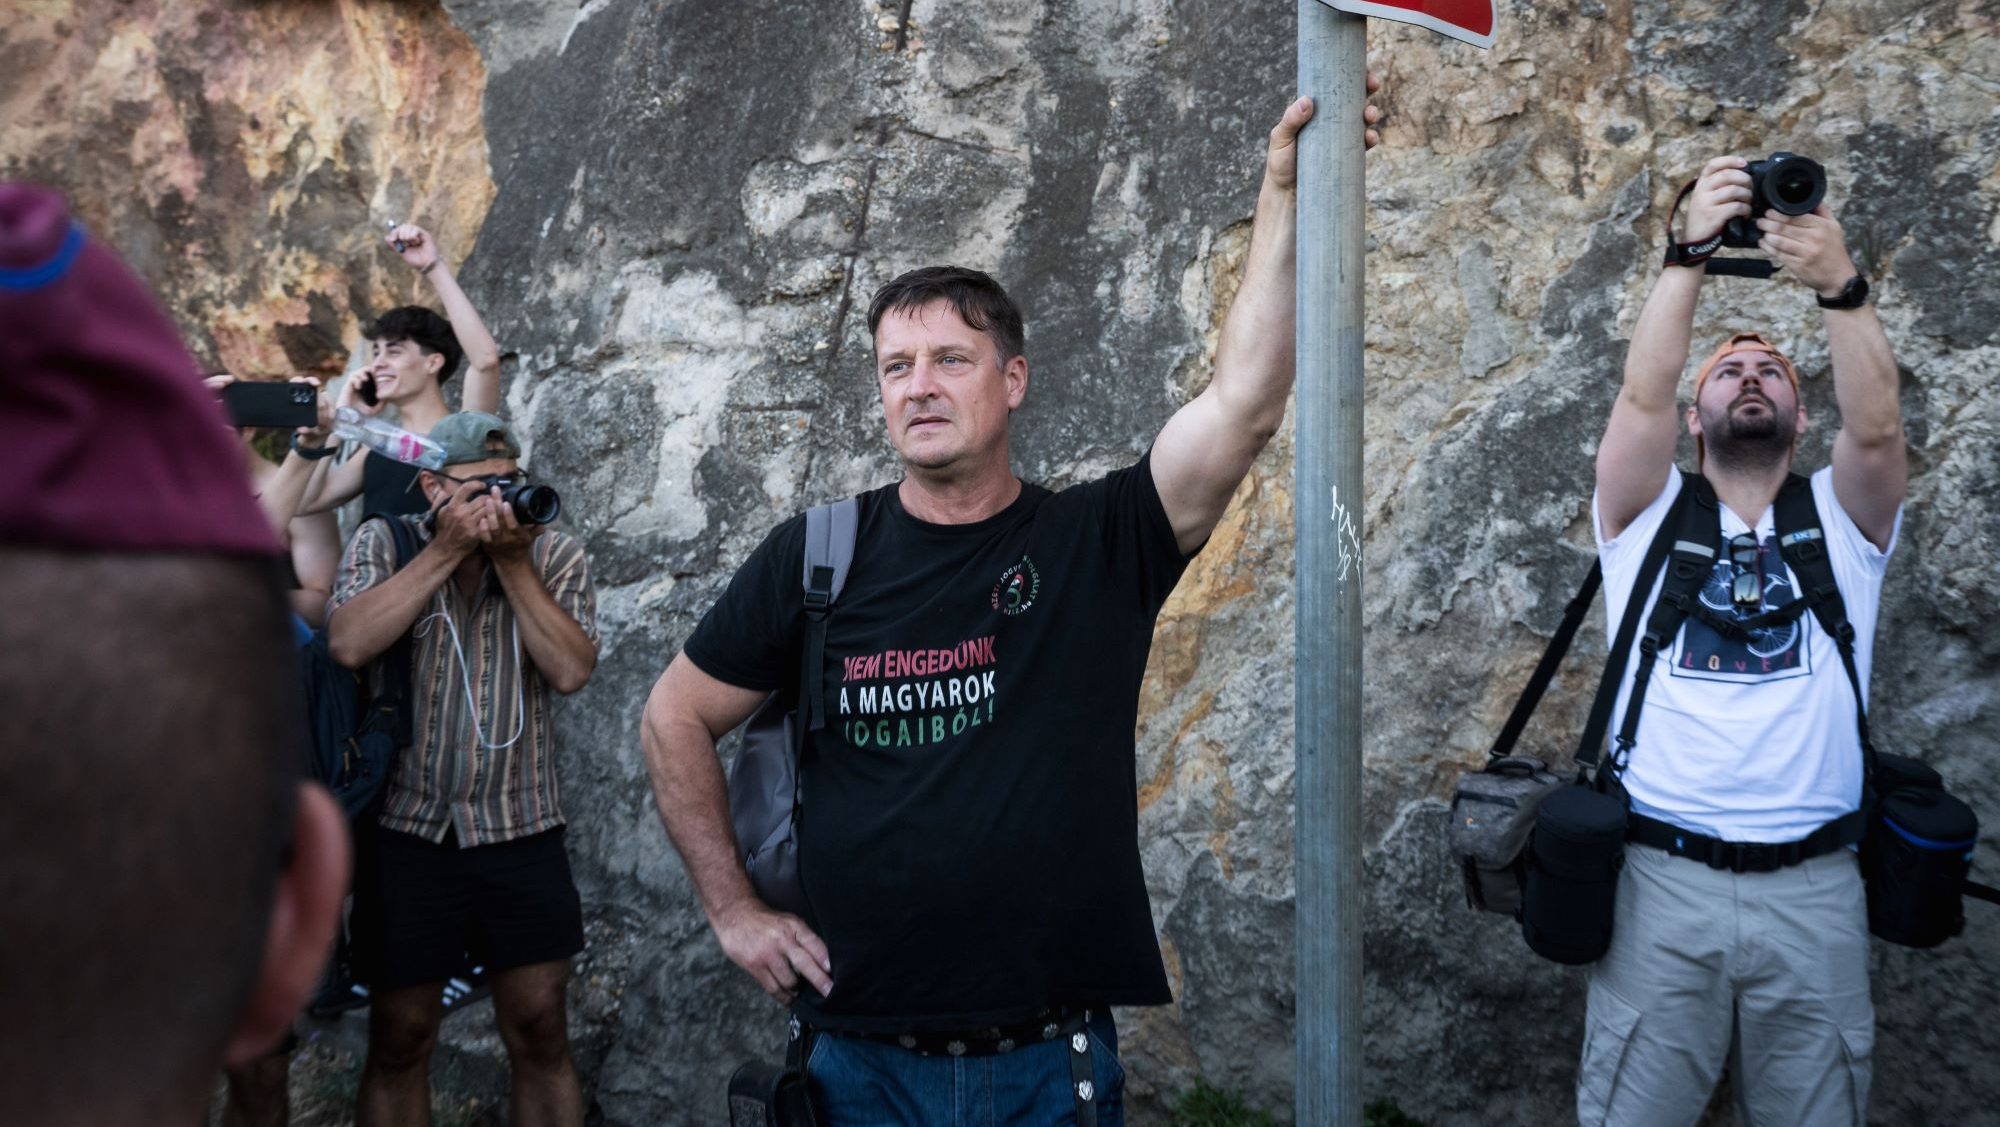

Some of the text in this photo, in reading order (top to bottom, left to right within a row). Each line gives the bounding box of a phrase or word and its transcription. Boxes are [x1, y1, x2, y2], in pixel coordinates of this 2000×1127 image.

[1688, 235, 1722, 255] Canon
[842, 635, 997, 682] NEM ENGEDÜNK
[839, 670, 996, 715] A MAGYAROK
